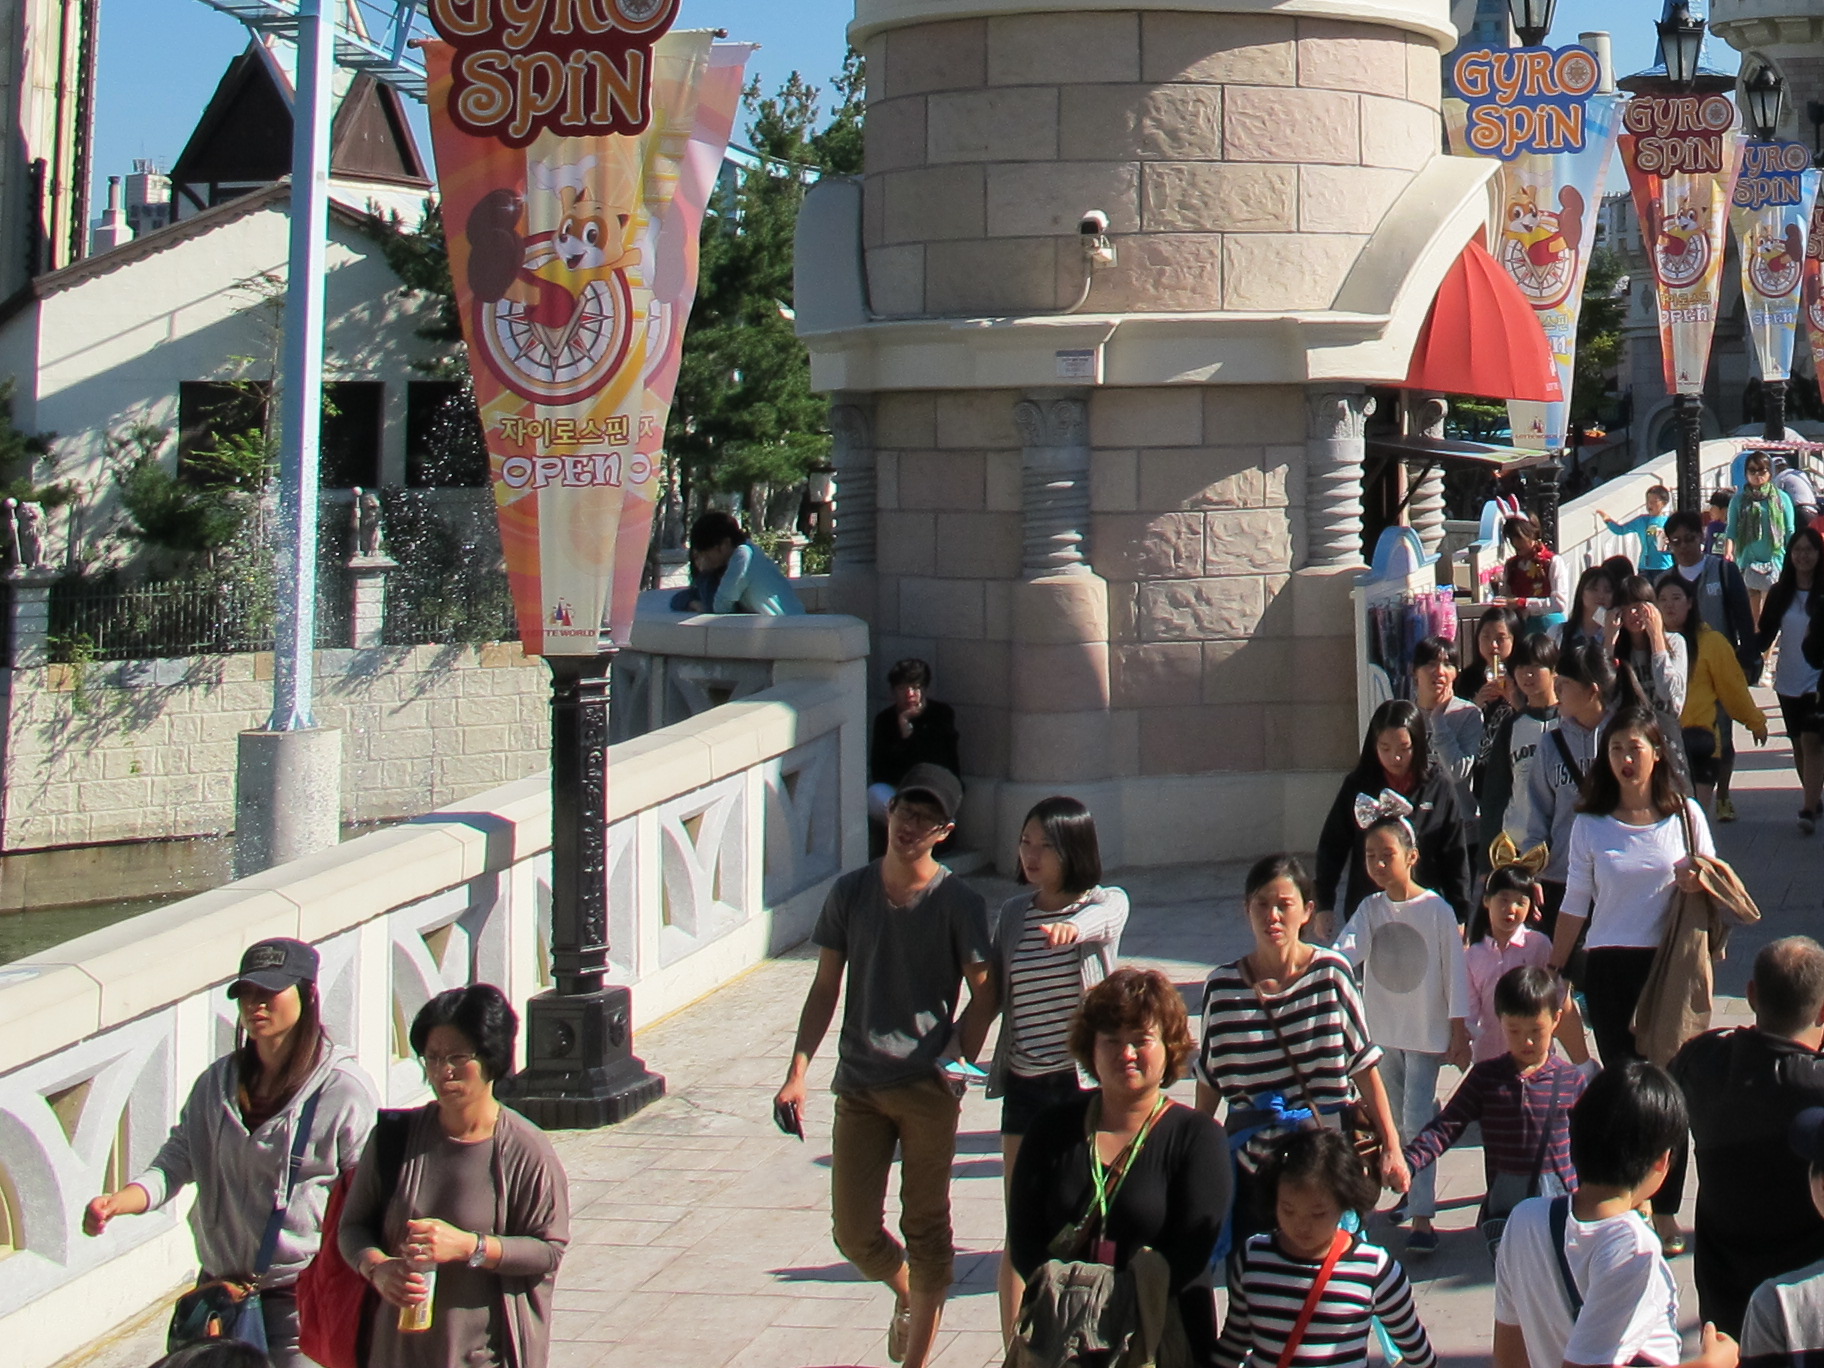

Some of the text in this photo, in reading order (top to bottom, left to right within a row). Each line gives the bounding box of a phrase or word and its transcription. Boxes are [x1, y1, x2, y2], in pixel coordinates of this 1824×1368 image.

[458, 47, 646, 139] SPIN
[1454, 49, 1598, 105] GYRO
[1471, 104, 1582, 155] SPIN
[1625, 96, 1732, 138] GYRO
[1638, 136, 1720, 175] SPIN
[1741, 144, 1808, 178] YRO
[1734, 176, 1799, 208] SPIN
[500, 416, 630, 448] 자이로스핀
[502, 452, 624, 489] OPEN
